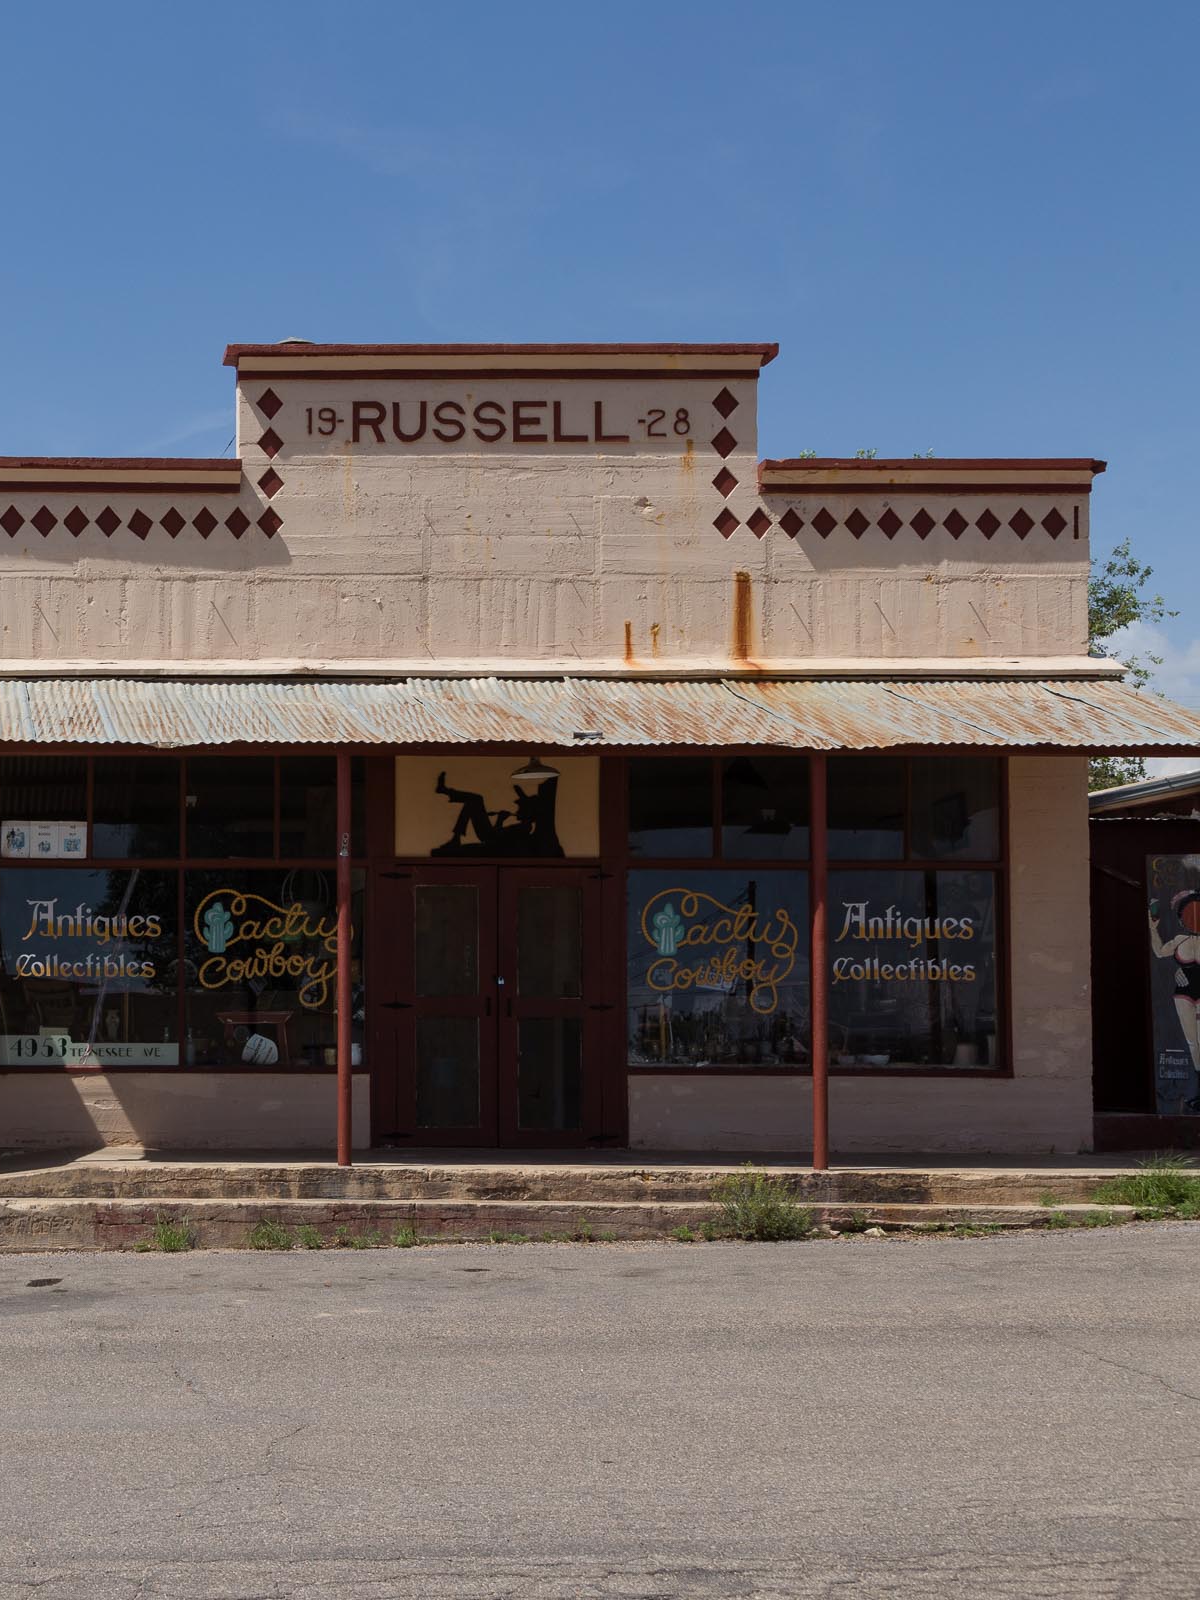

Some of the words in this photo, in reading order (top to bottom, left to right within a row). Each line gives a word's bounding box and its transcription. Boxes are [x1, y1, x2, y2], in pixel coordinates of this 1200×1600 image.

[352, 401, 630, 442] RUSSELL
[21, 897, 163, 946] Antiques
[641, 887, 799, 959] Cactus
[834, 900, 976, 948] Antiques
[13, 952, 157, 981] Collectibles
[646, 947, 778, 1015] Cowboy
[832, 955, 977, 985] Collectibles
[9, 1037, 68, 1058] 4953
[71, 1046, 133, 1058] TENESSEE
